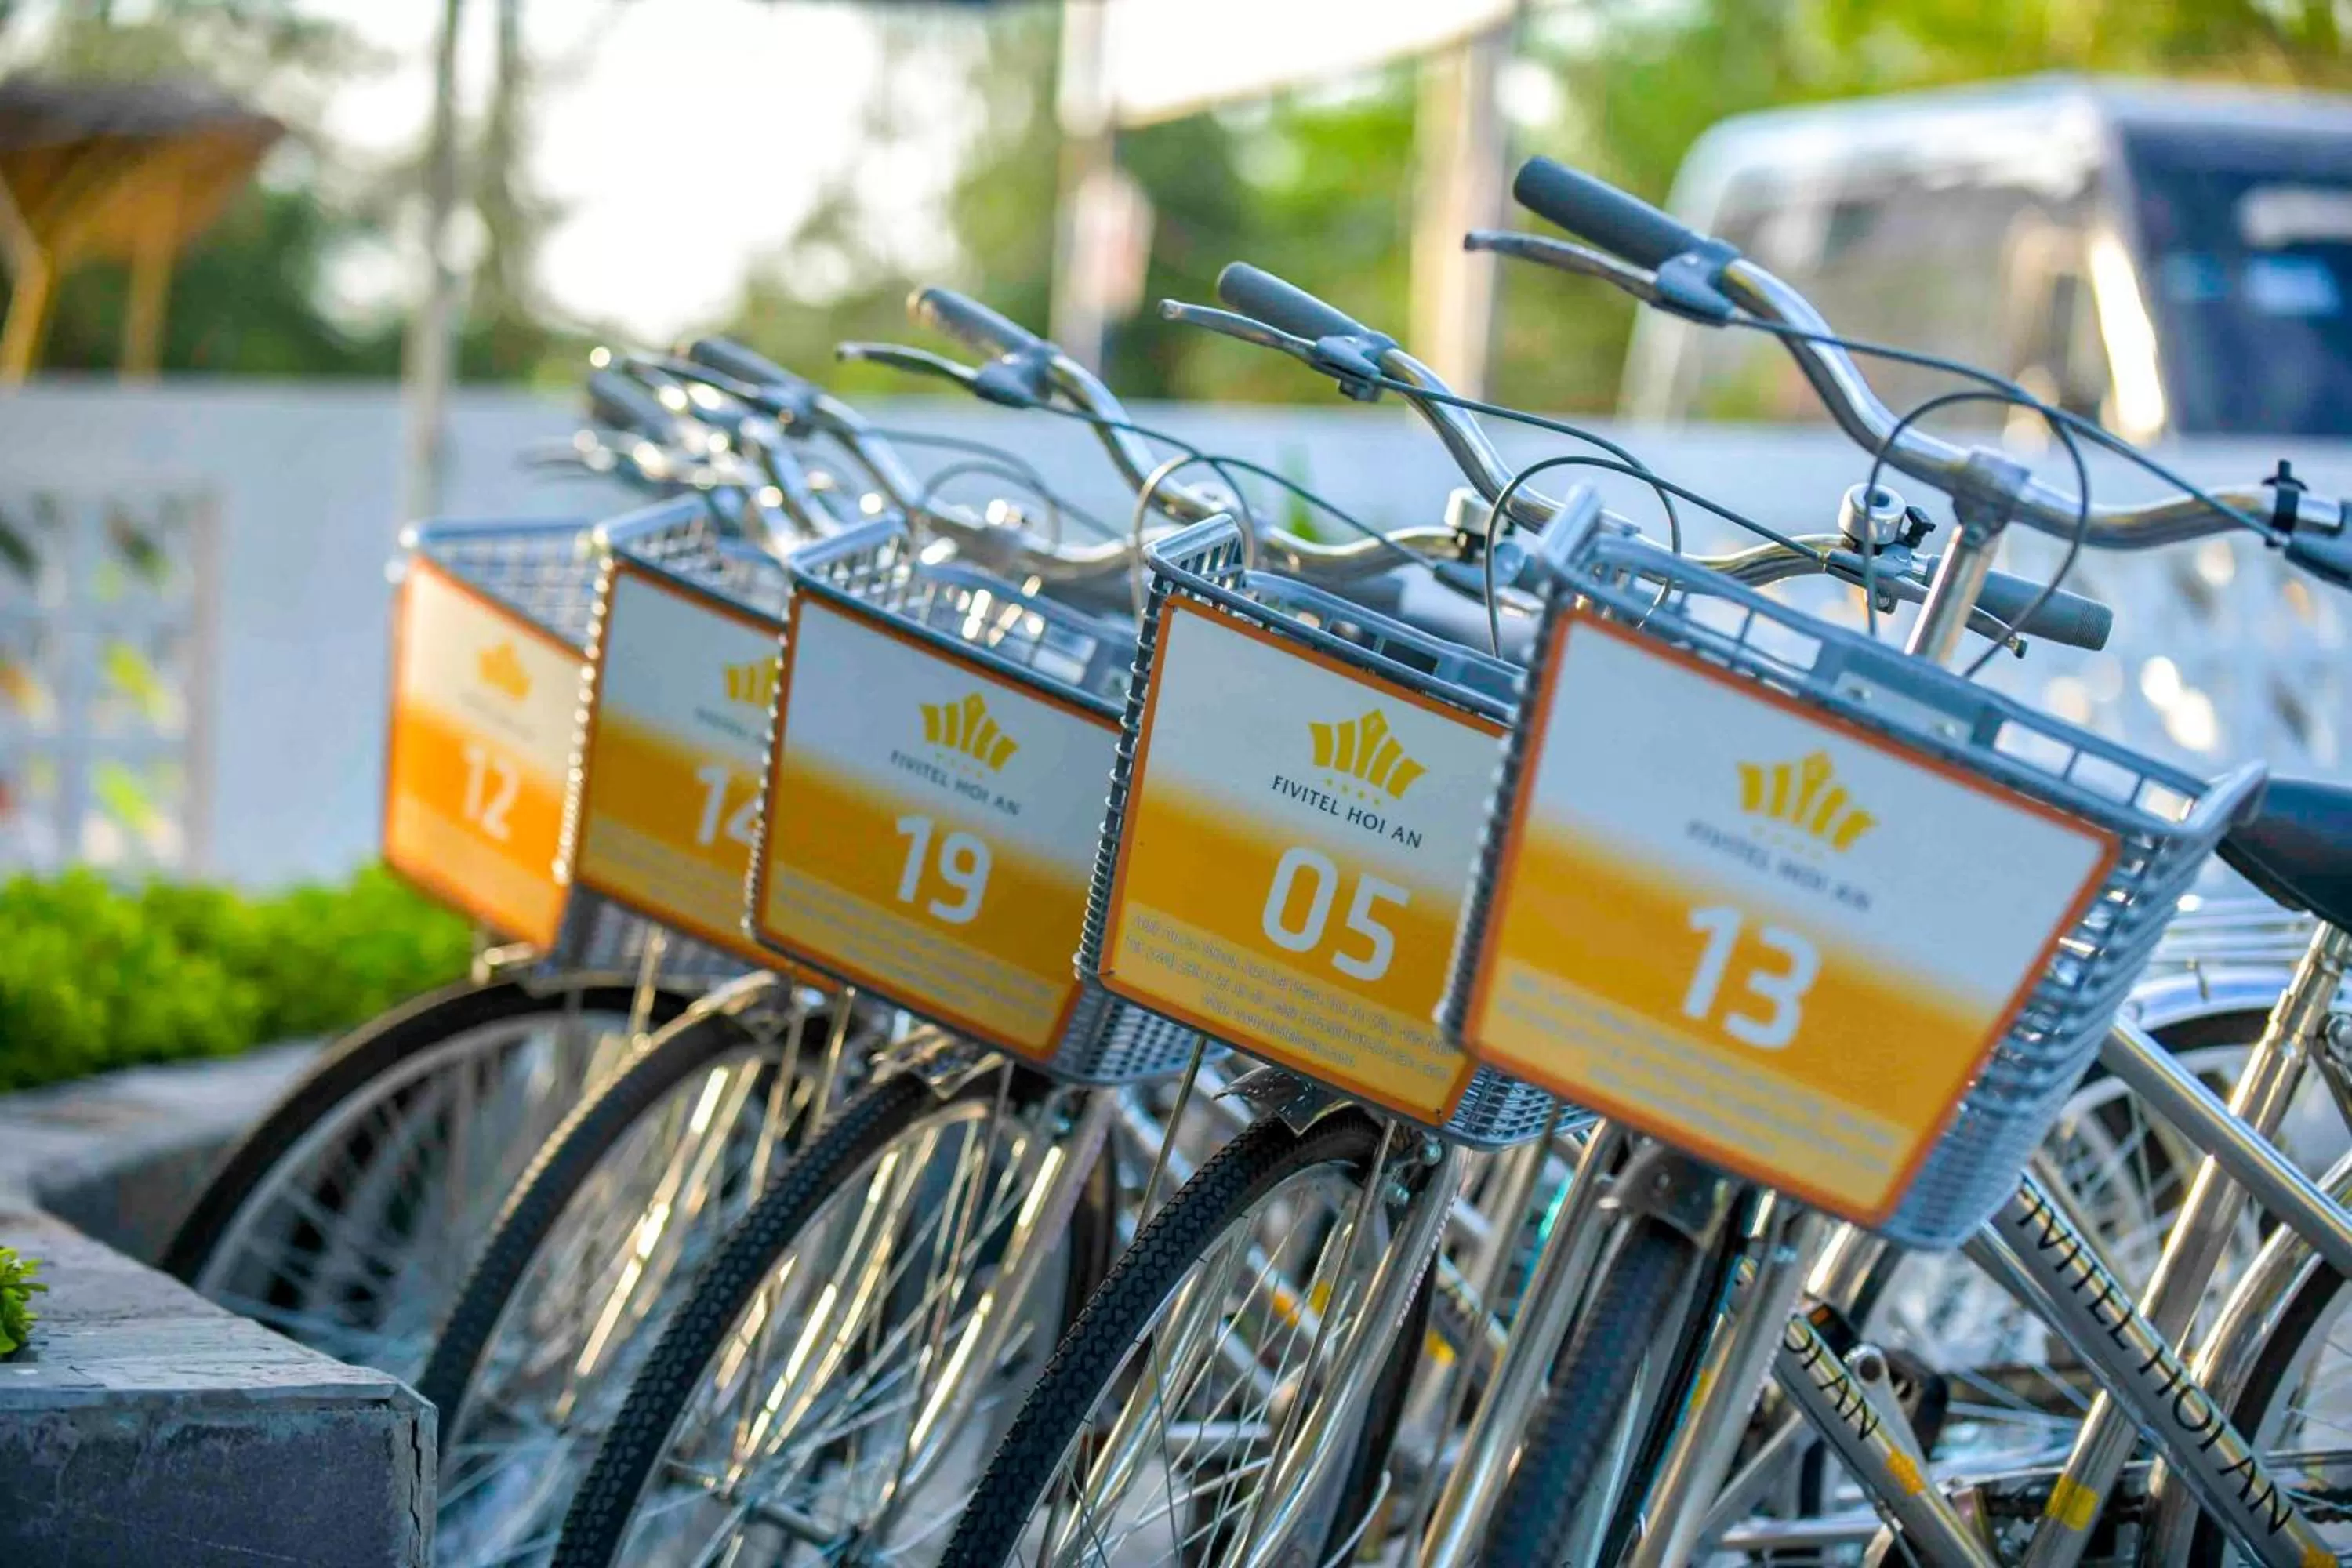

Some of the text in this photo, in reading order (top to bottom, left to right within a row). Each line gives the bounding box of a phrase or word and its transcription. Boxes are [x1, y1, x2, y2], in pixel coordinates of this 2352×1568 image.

[463, 745, 519, 841] 12
[1272, 775, 1423, 849] FIVITEL HOI AN
[897, 815, 990, 924] 19
[1262, 847, 1408, 982] 05
[1682, 905, 1820, 1049] 13
[1817, 1374, 1880, 1441] AN
[2137, 1345, 2225, 1451] HOI
[2218, 1456, 2293, 1534] AN
